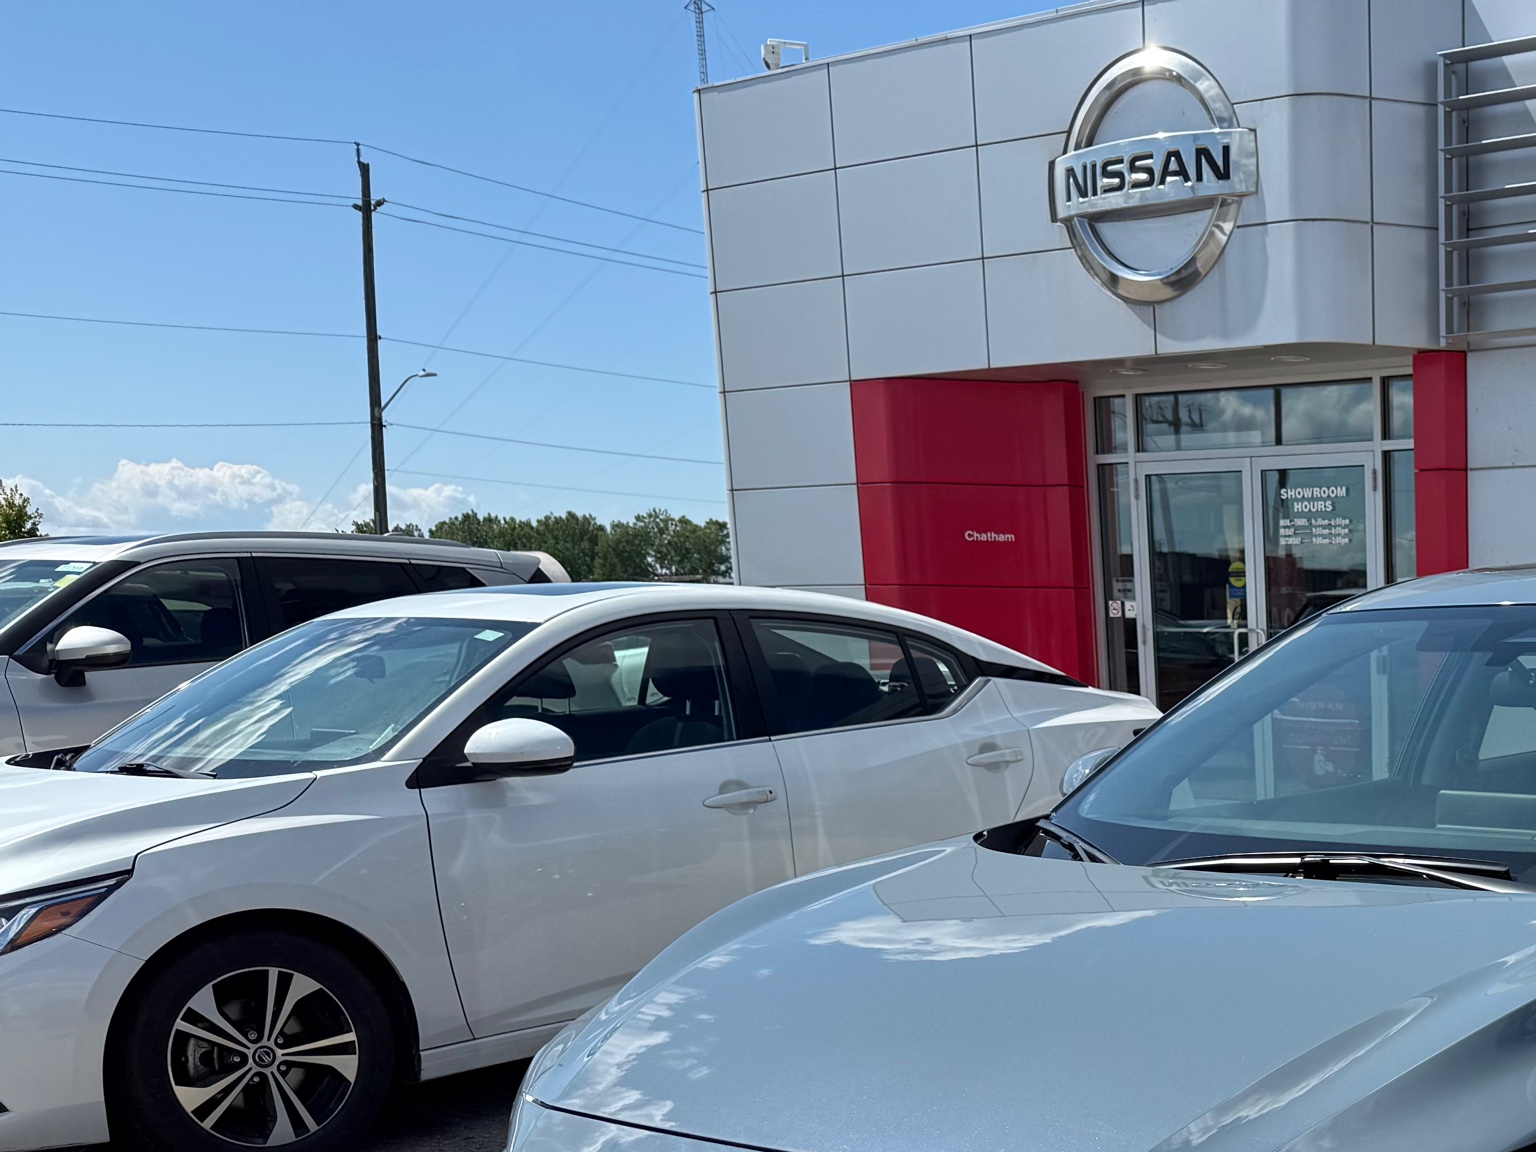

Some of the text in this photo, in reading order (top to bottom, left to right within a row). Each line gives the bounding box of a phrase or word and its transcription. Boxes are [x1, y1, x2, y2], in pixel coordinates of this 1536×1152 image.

[1064, 144, 1231, 204] NISSAN
[1280, 486, 1347, 499] SHOWROOM
[1293, 501, 1333, 512] HOURS
[964, 530, 1016, 542] Chatham
[1296, 700, 1345, 711] NISSAN
